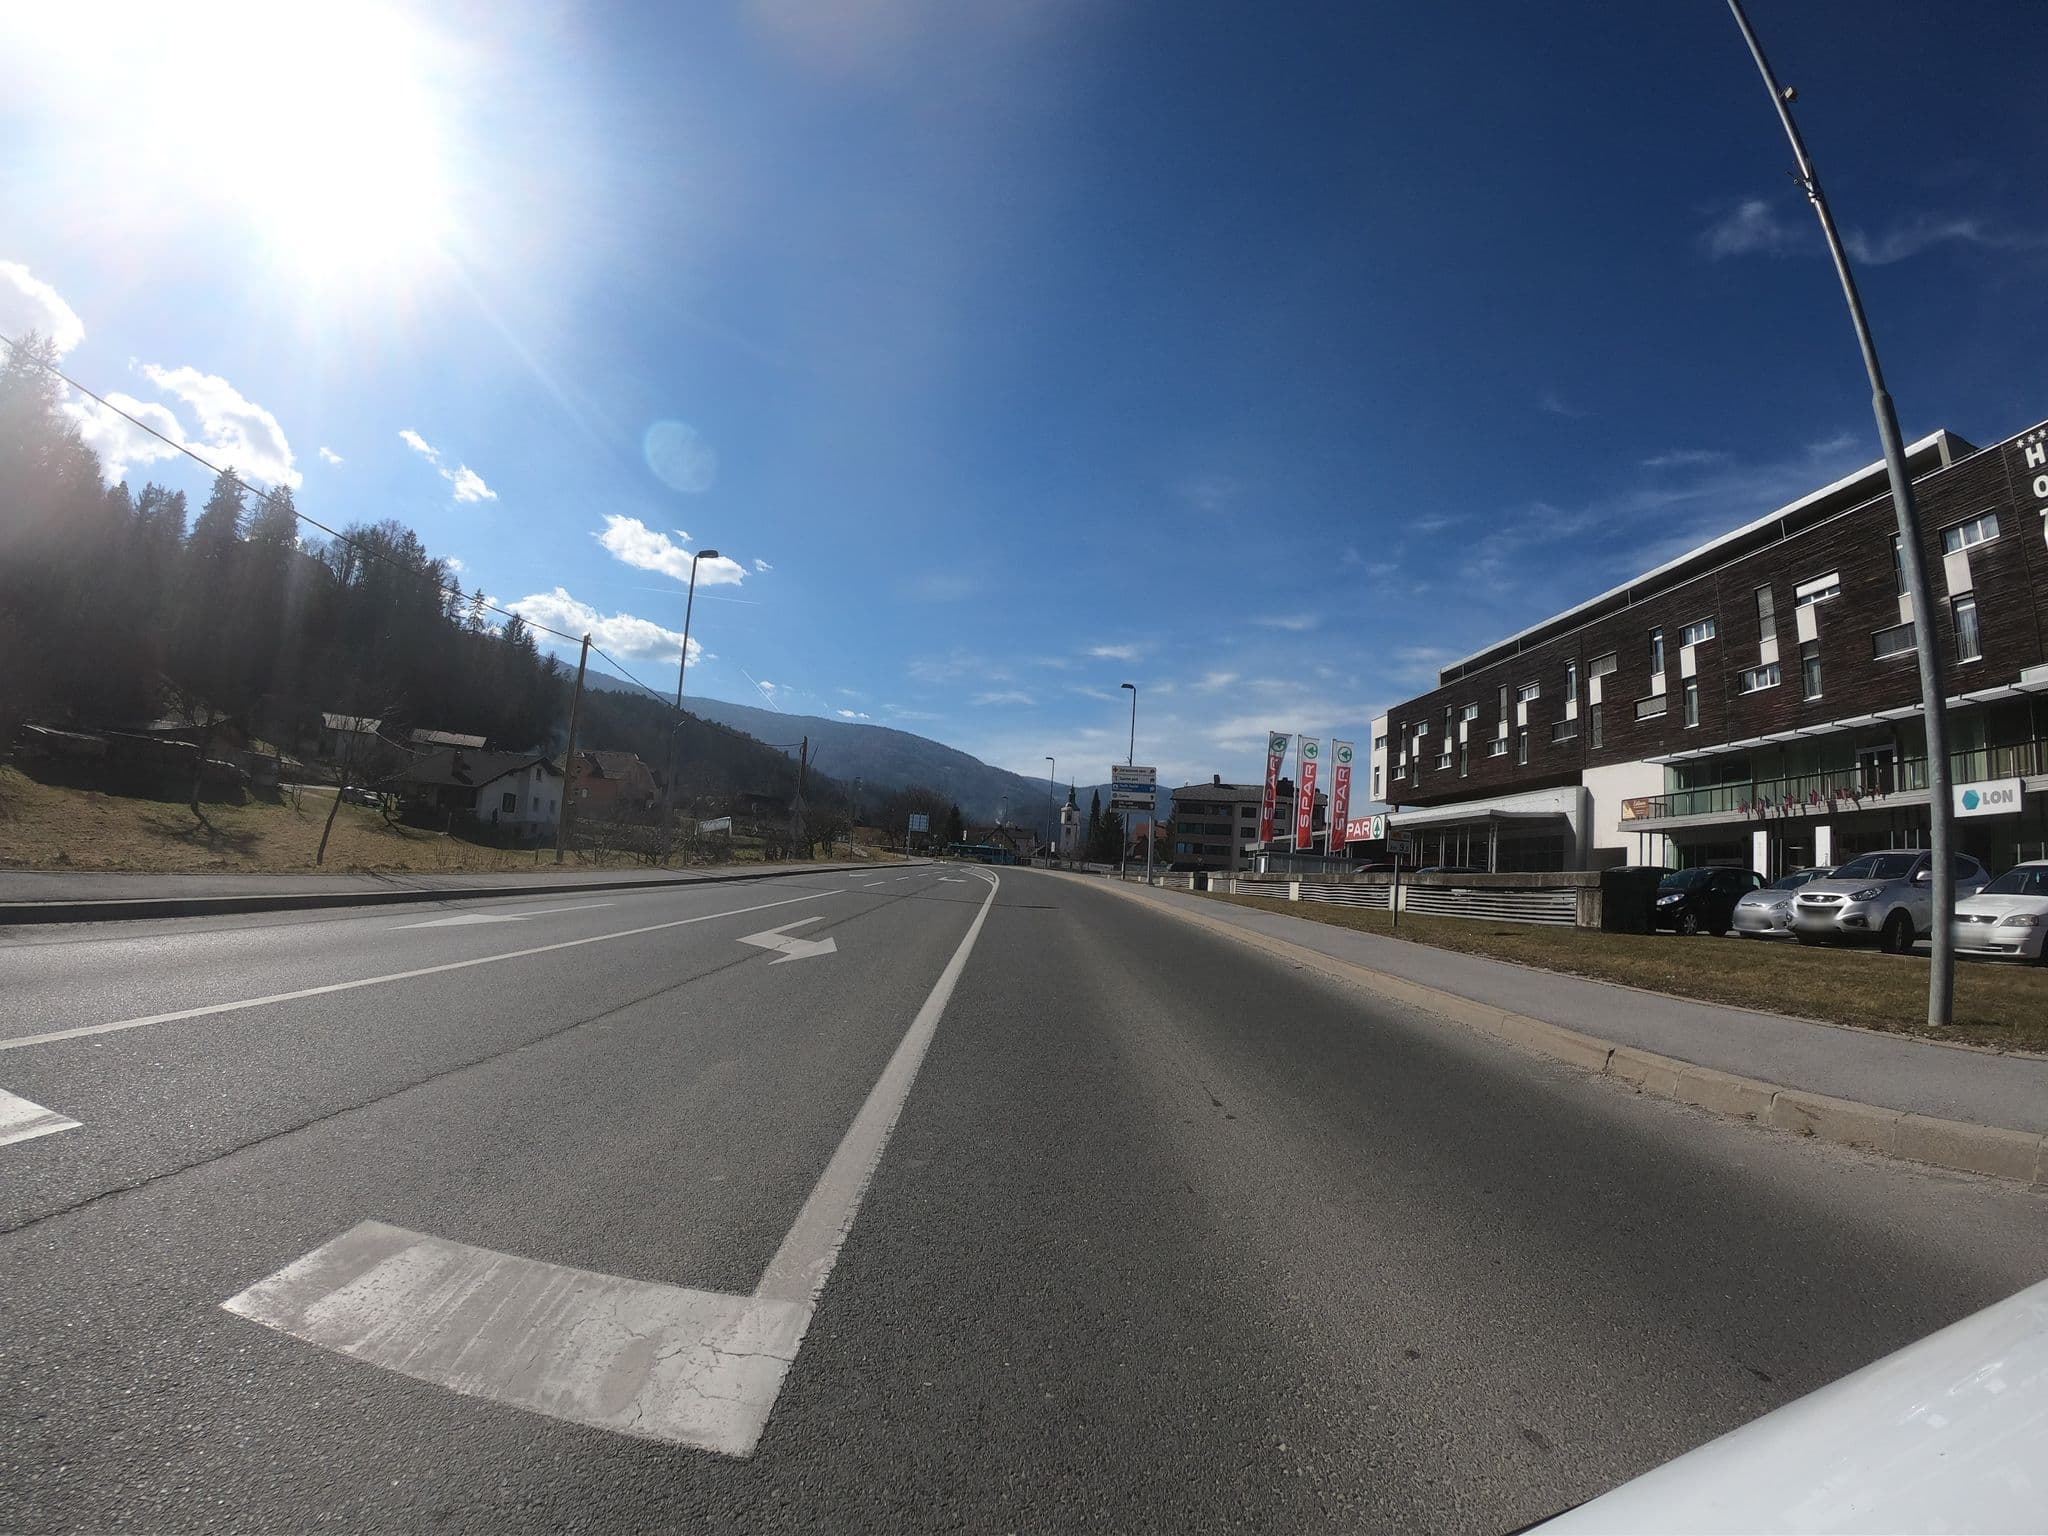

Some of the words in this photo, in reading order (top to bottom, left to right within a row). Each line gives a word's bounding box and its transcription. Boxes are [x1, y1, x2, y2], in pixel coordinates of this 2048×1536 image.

[1264, 756, 1280, 821] SPAR
[1300, 764, 1315, 828] SPAR
[1335, 768, 1349, 831] SPAR
[1982, 789, 2013, 805] LON
[1346, 820, 1371, 838] PAR
